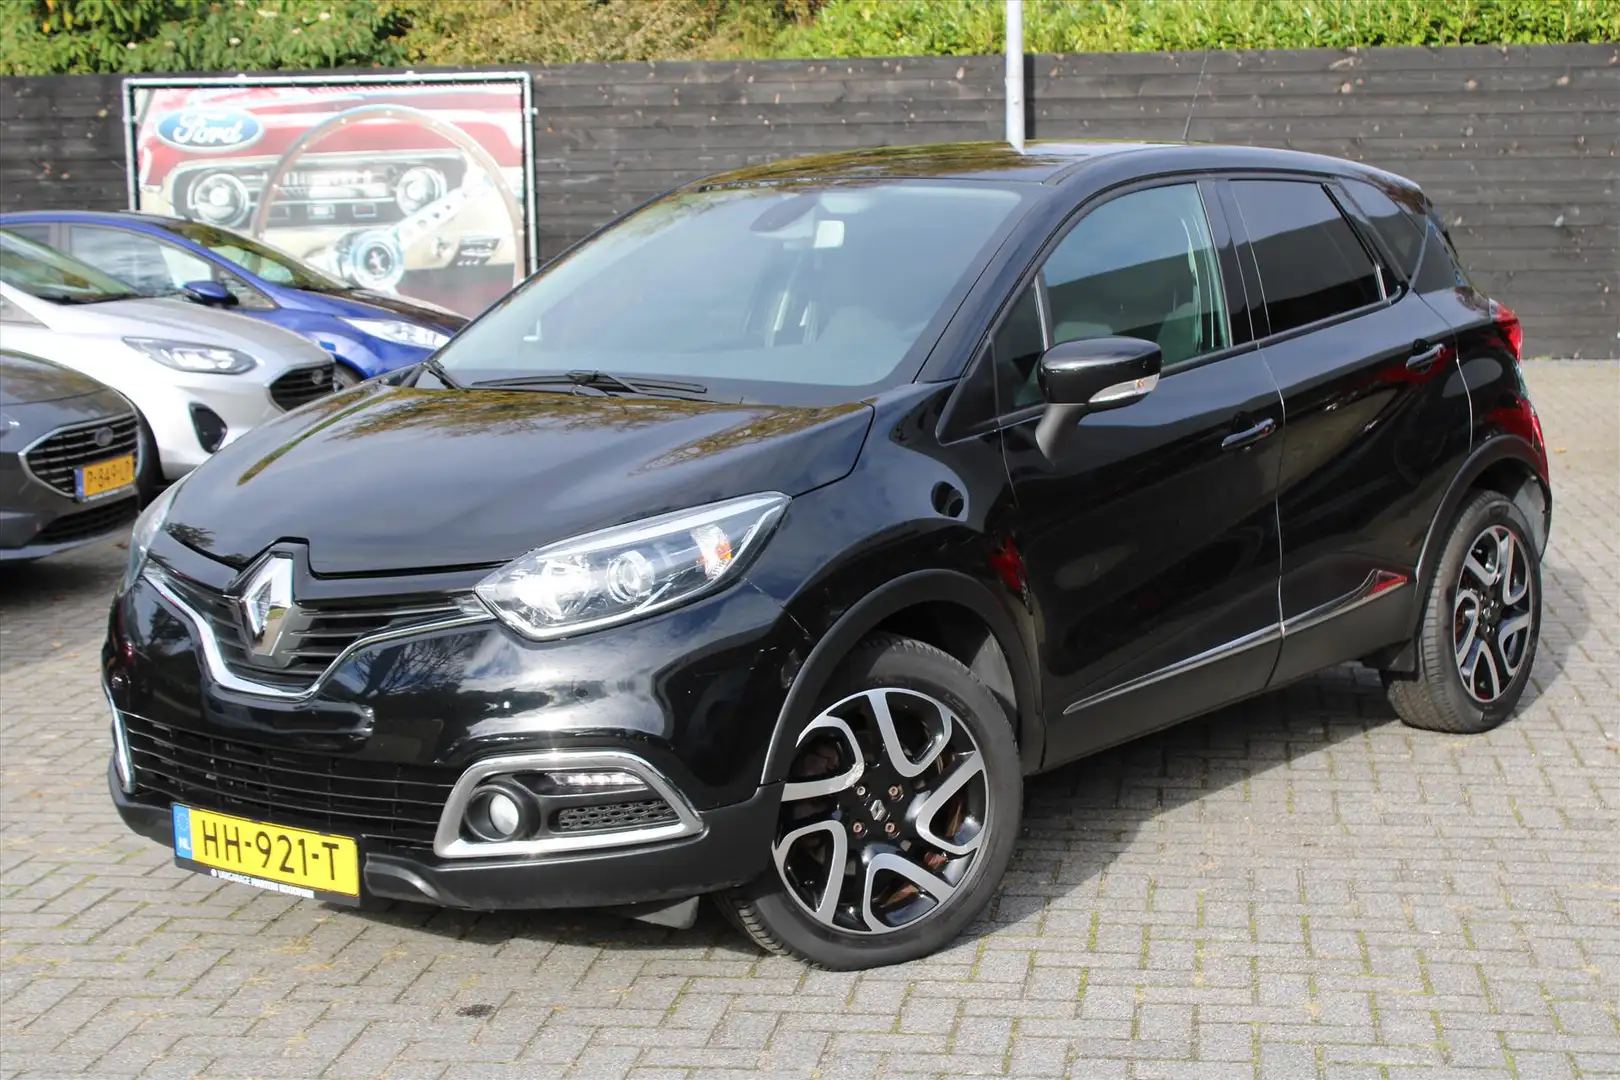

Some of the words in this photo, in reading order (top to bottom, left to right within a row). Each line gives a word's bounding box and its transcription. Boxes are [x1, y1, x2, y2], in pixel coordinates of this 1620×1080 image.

[172, 112, 243, 144] Ford
[178, 836, 191, 850] NL
[202, 819, 340, 881] HH-921-T
